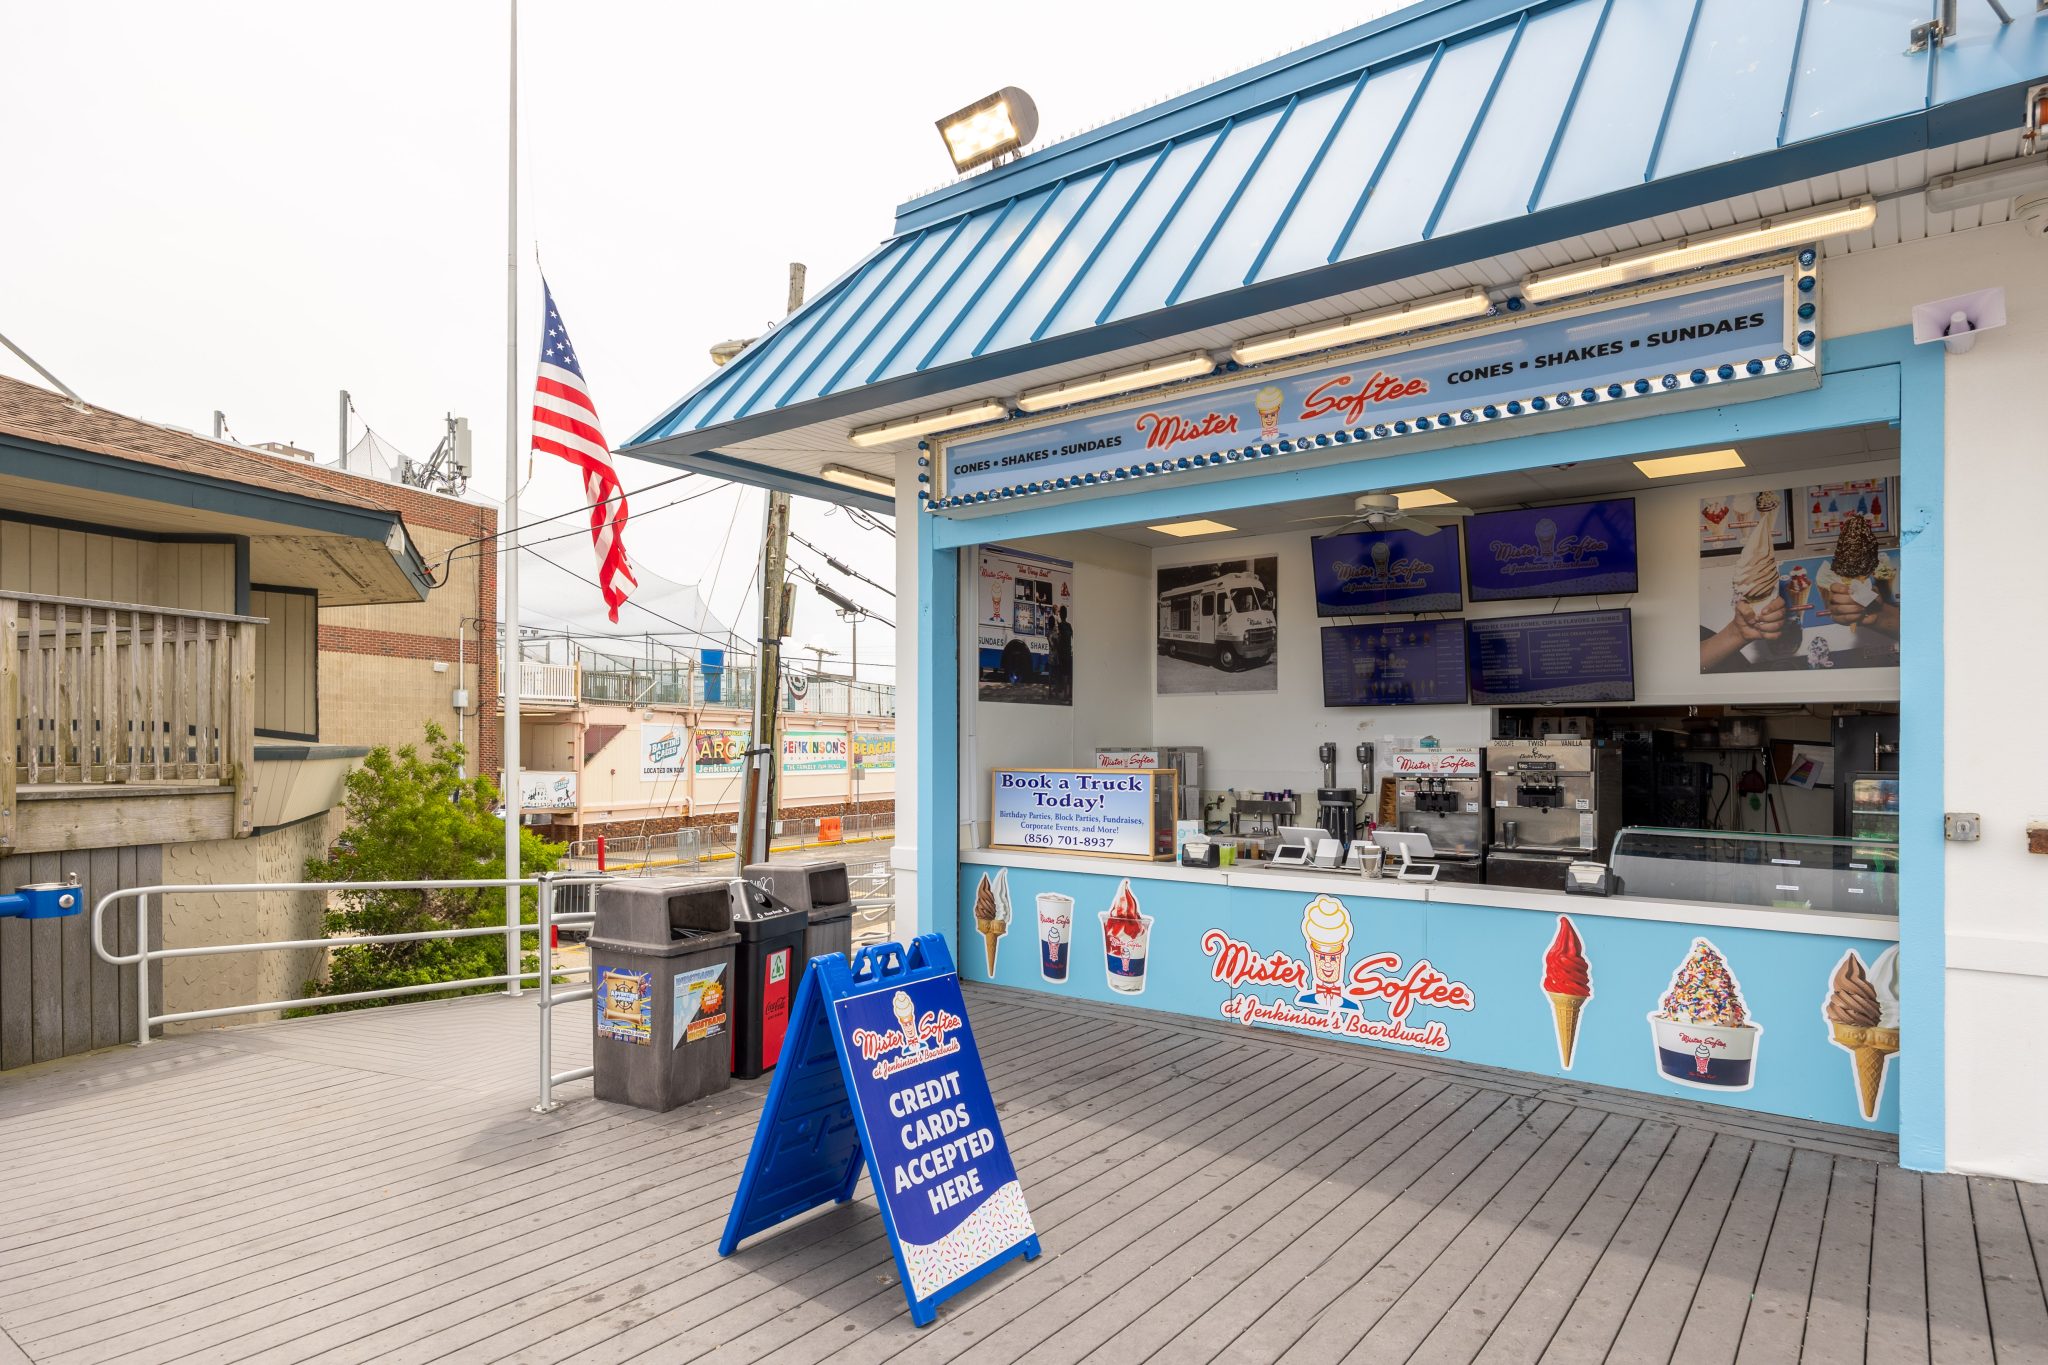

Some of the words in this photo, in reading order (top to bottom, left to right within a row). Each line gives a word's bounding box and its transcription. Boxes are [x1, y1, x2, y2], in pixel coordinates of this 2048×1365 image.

[1447, 361, 1514, 385] CONES
[1533, 340, 1624, 369] SHAKES
[1646, 312, 1765, 348] SUNDAES
[1135, 412, 1239, 449] Mister
[1300, 372, 1425, 424] Softee
[953, 459, 991, 476] CONES
[1001, 449, 1050, 467] SHAKES
[1060, 435, 1123, 457] SUNDAES
[650, 737, 681, 753] BATTING
[1099, 754, 1123, 767] Mister
[1129, 753, 1155, 768] Softee
[1396, 756, 1430, 772] Mister
[1440, 755, 1476, 774] Softee
[1001, 773, 1052, 789] Book
[1058, 778, 1070, 790] a
[1076, 775, 1143, 792] Truck
[1033, 792, 1105, 812] Today!
[999, 810, 1027, 820] Birthday
[1055, 813, 1074, 822] Block
[1020, 821, 1054, 833] Corporate
[1082, 825, 1096, 833] and
[1098, 825, 1119, 834] More!
[1024, 833, 1054, 846] (856)
[1058, 835, 1114, 848] 701-8937
[1204, 932, 1305, 988] Mister
[1349, 957, 1467, 1018] Softee
[854, 1031, 903, 1060] Mister
[919, 1011, 960, 1041] Softee
[1224, 1000, 1241, 1014] at
[1244, 998, 1341, 1029] Jenkinson's
[1346, 1014, 1446, 1048] Boardwalk
[873, 1066, 883, 1077] at
[883, 1051, 923, 1077] Jenkinson's
[924, 1041, 959, 1060] Boardwalk
[889, 1071, 961, 1118] CREDIT
[900, 1103, 970, 1150] CARDS
[894, 1128, 995, 1194] ACCEPTED
[927, 1168, 984, 1215] HERE
